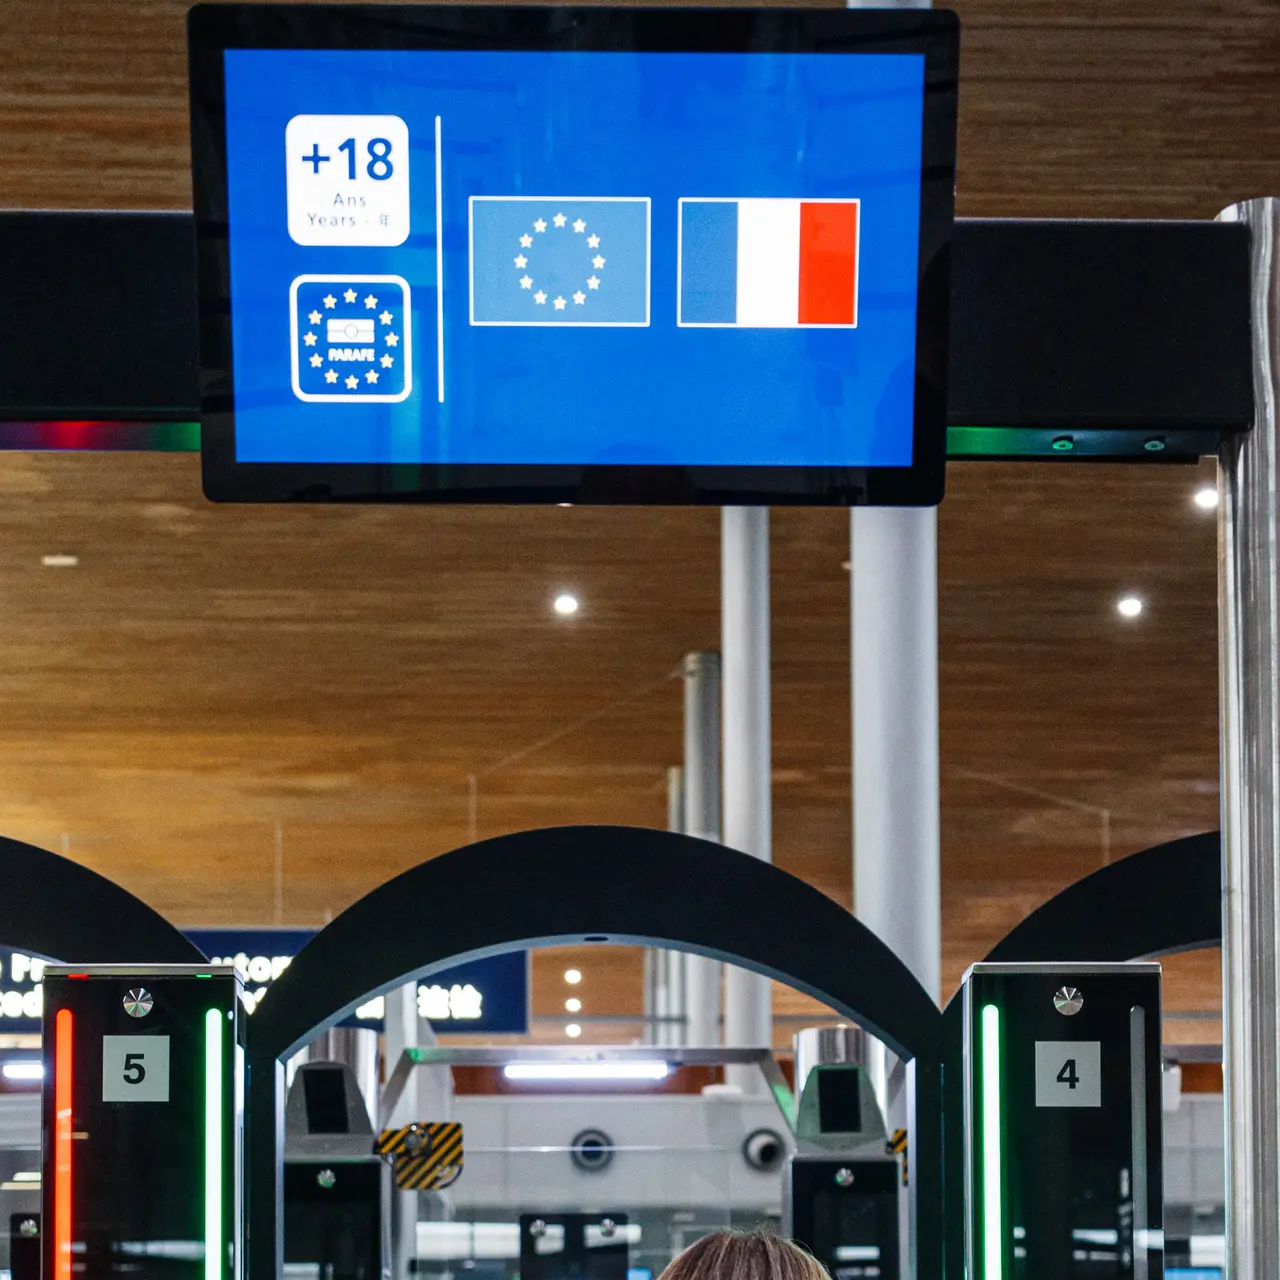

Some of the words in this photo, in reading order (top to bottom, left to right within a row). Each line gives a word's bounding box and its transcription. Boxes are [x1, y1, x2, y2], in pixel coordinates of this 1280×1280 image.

[302, 138, 394, 181] +18
[333, 193, 367, 207] Ans
[307, 212, 357, 227] Years
[328, 347, 375, 362] PARAFE
[122, 1053, 146, 1085] 5
[1055, 1058, 1080, 1090] 4
